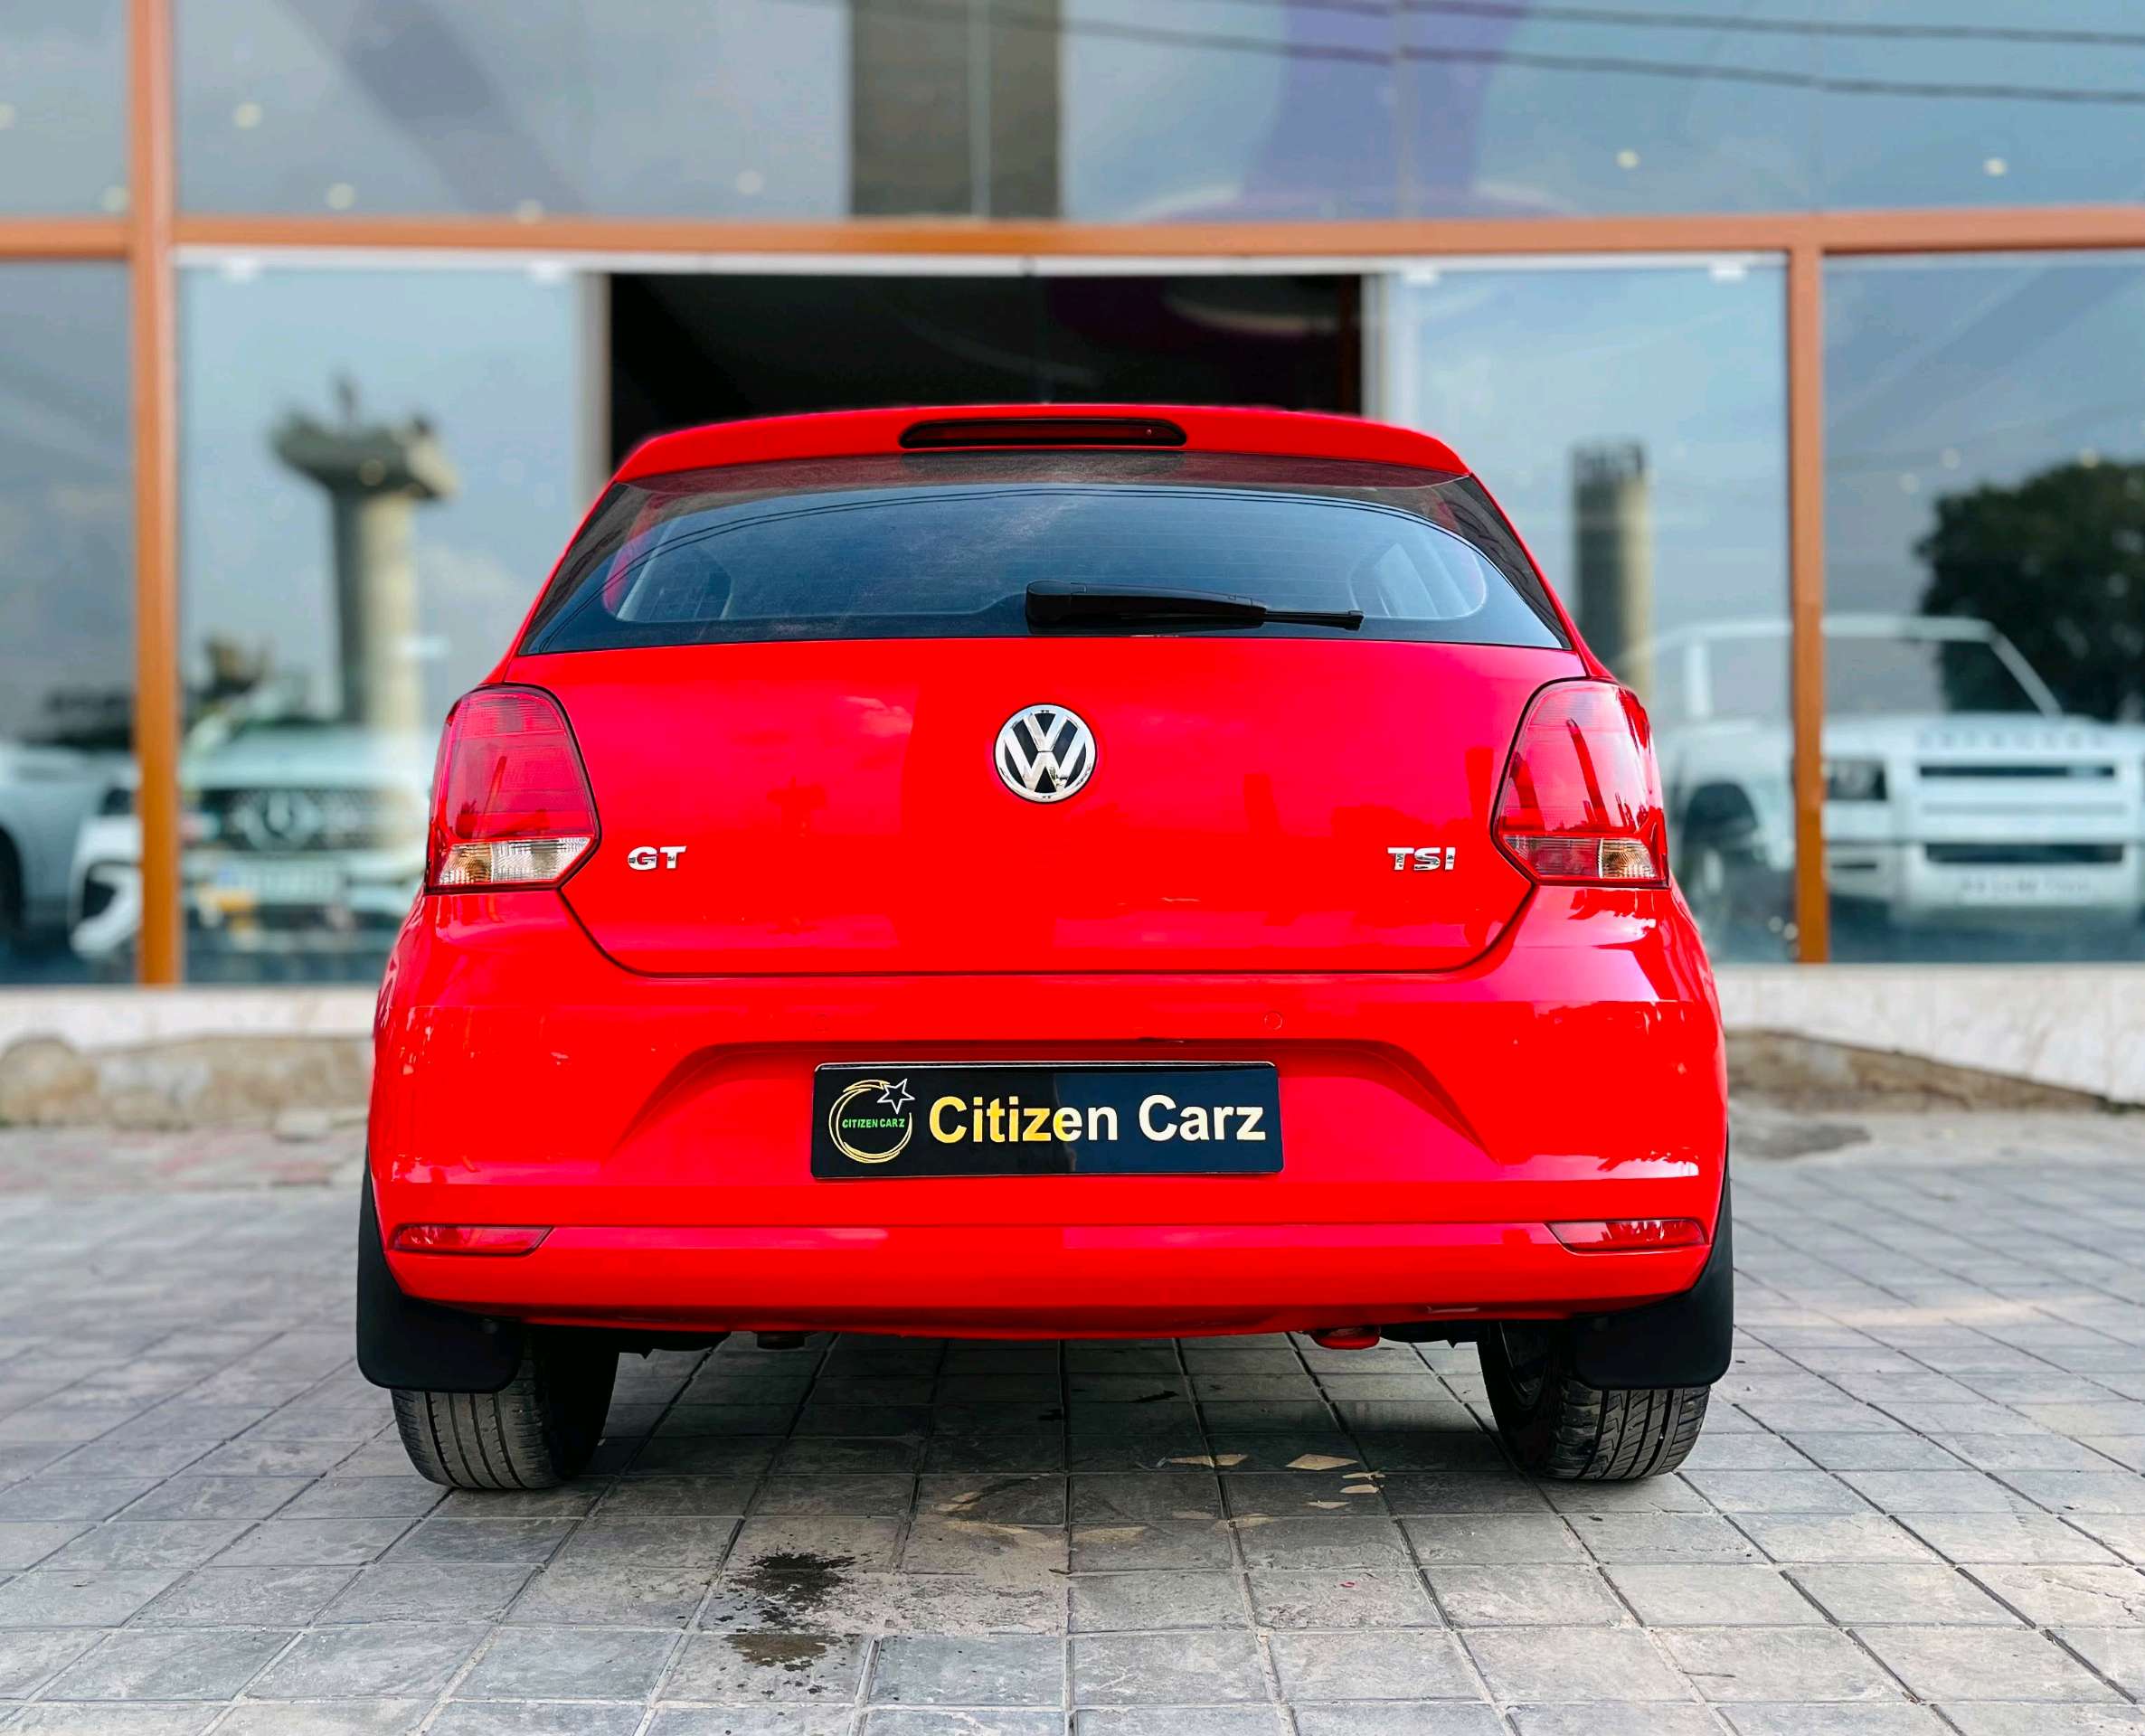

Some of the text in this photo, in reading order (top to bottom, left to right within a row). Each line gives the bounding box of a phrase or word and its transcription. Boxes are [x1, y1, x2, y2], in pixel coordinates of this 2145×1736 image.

[628, 845, 687, 871] GT
[1387, 846, 1456, 871] TSI
[842, 1118, 905, 1128] CITIZEN CARZ
[929, 1094, 1266, 1144] Citizen Carz
